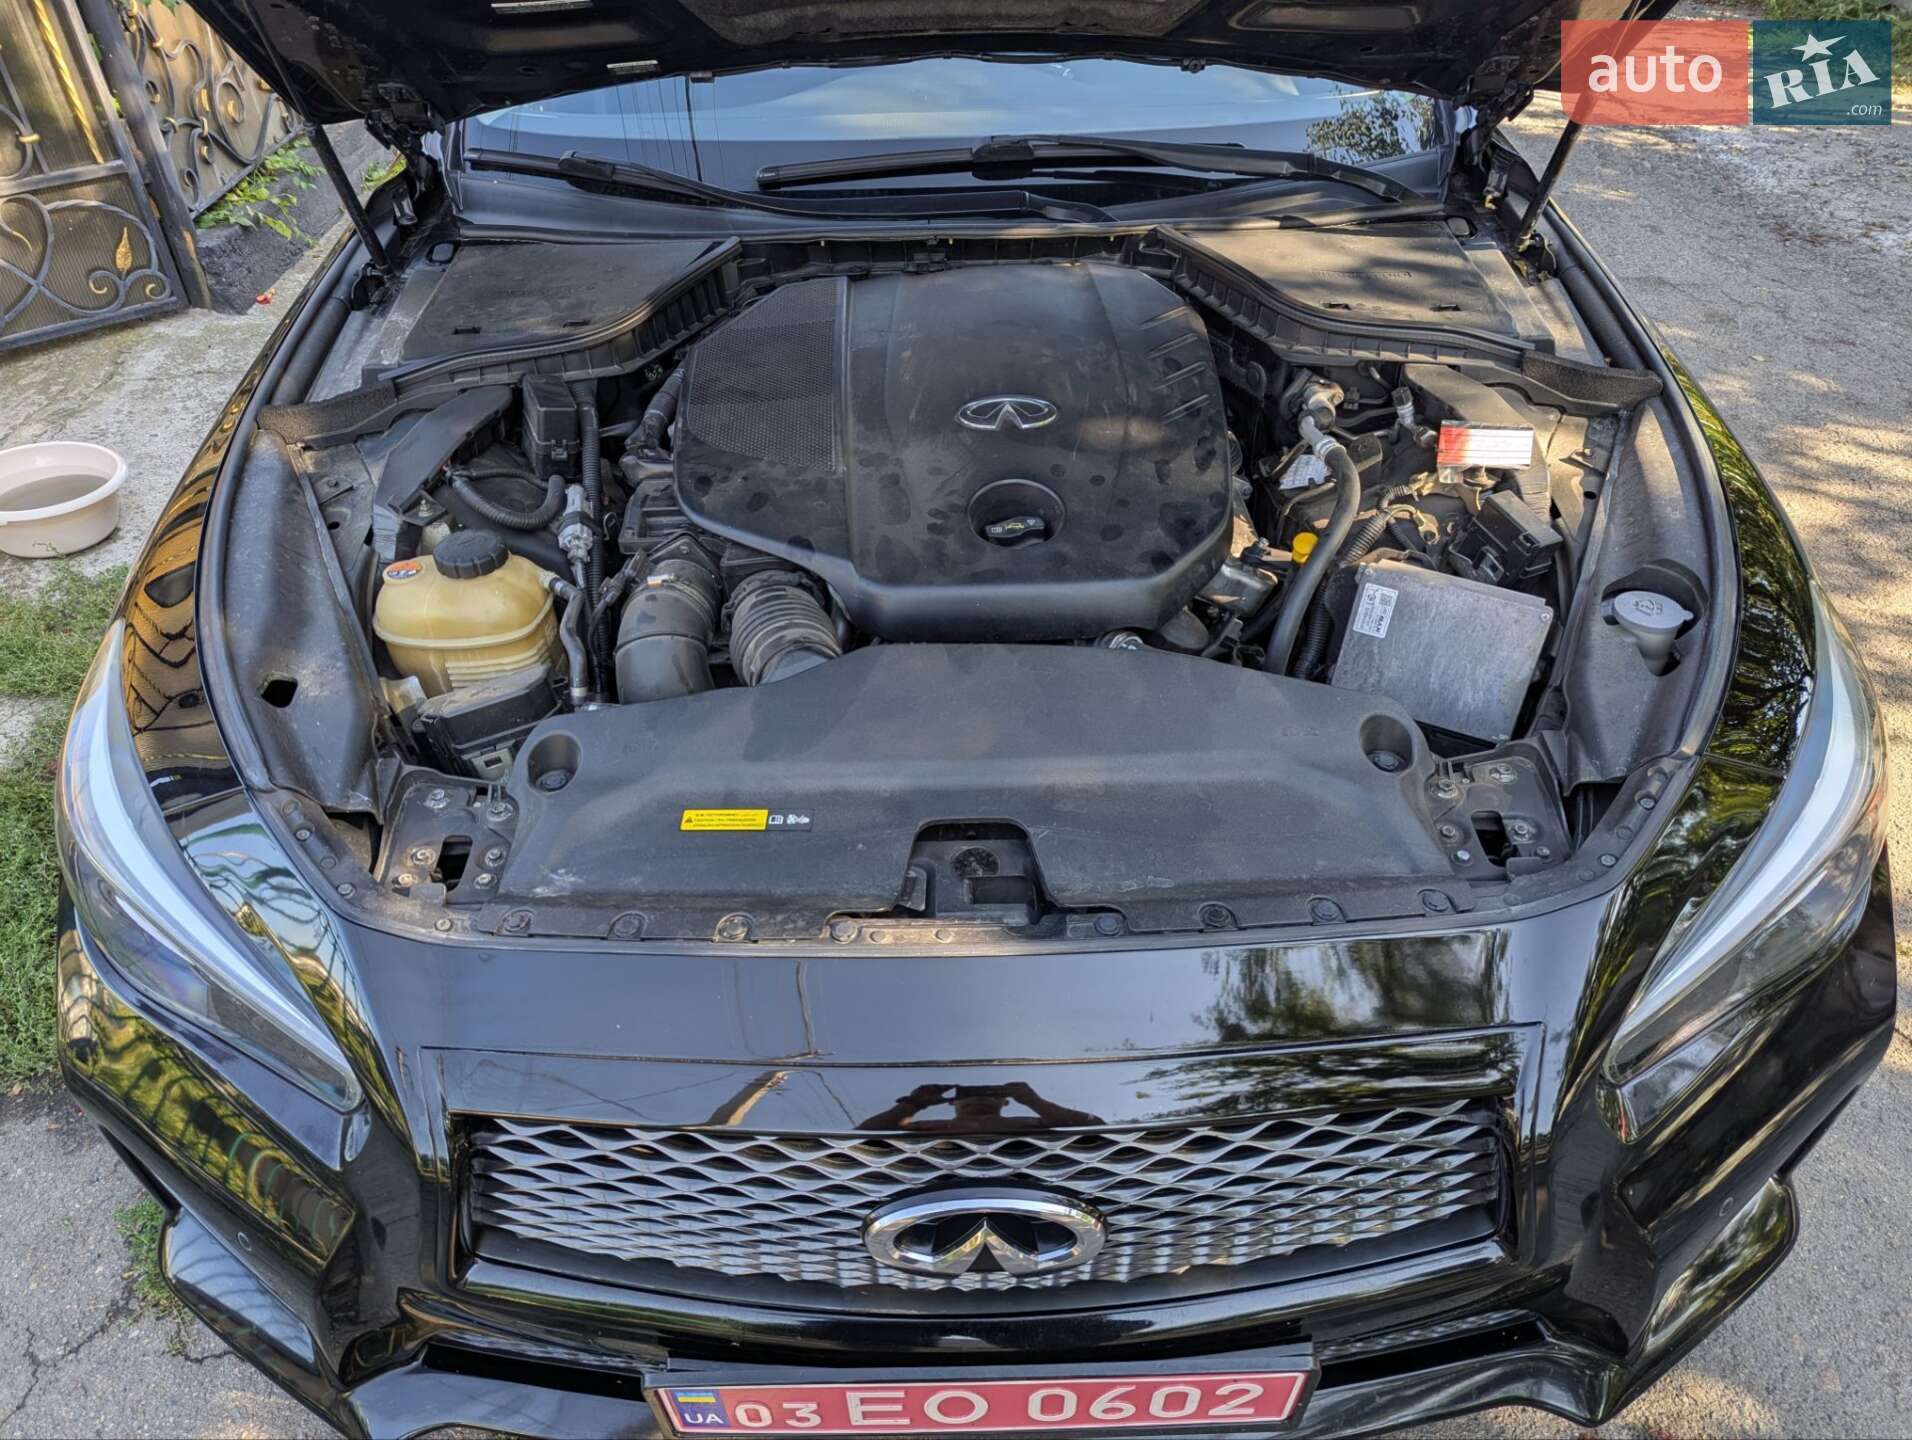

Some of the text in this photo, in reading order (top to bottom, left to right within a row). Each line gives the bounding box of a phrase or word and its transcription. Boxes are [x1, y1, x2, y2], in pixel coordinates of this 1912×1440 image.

[684, 1413, 724, 1424] UA
[735, 1383, 1264, 1428] 03 EO 0602
